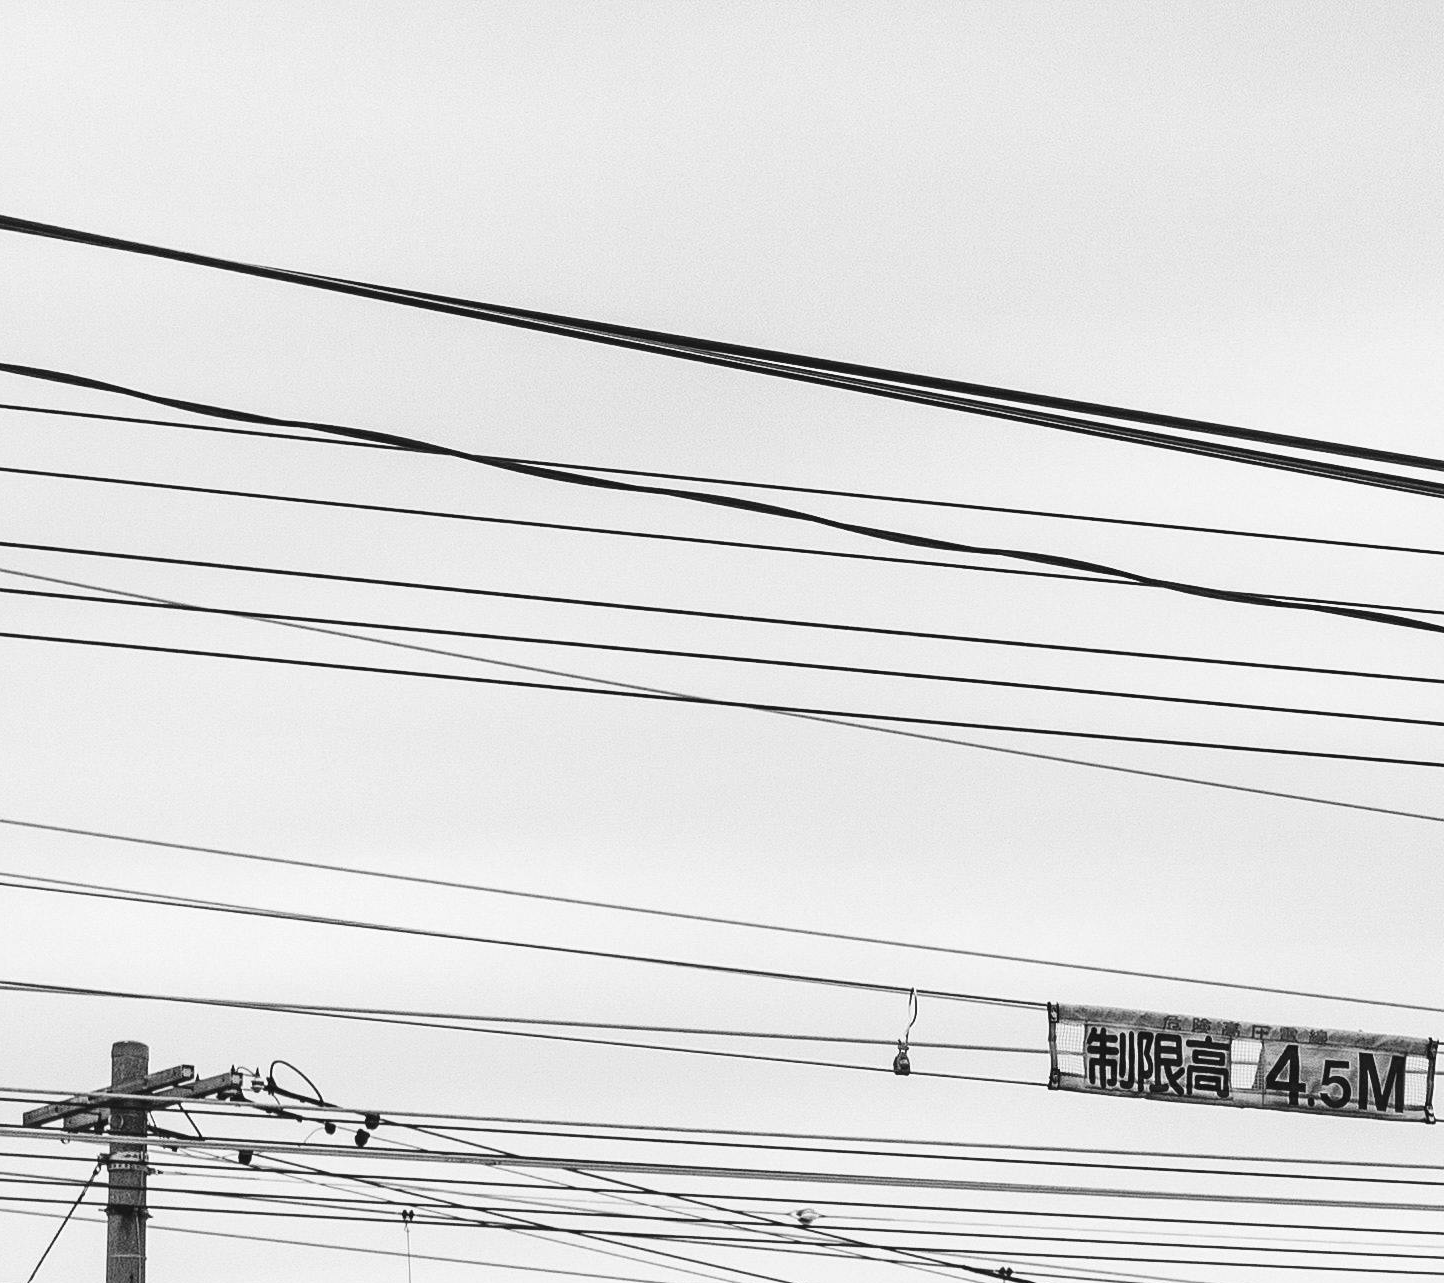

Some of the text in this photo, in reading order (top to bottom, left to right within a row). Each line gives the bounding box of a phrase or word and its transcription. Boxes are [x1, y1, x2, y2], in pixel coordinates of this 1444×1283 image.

[1085, 1026, 1406, 1114] 制限高 4.5M
